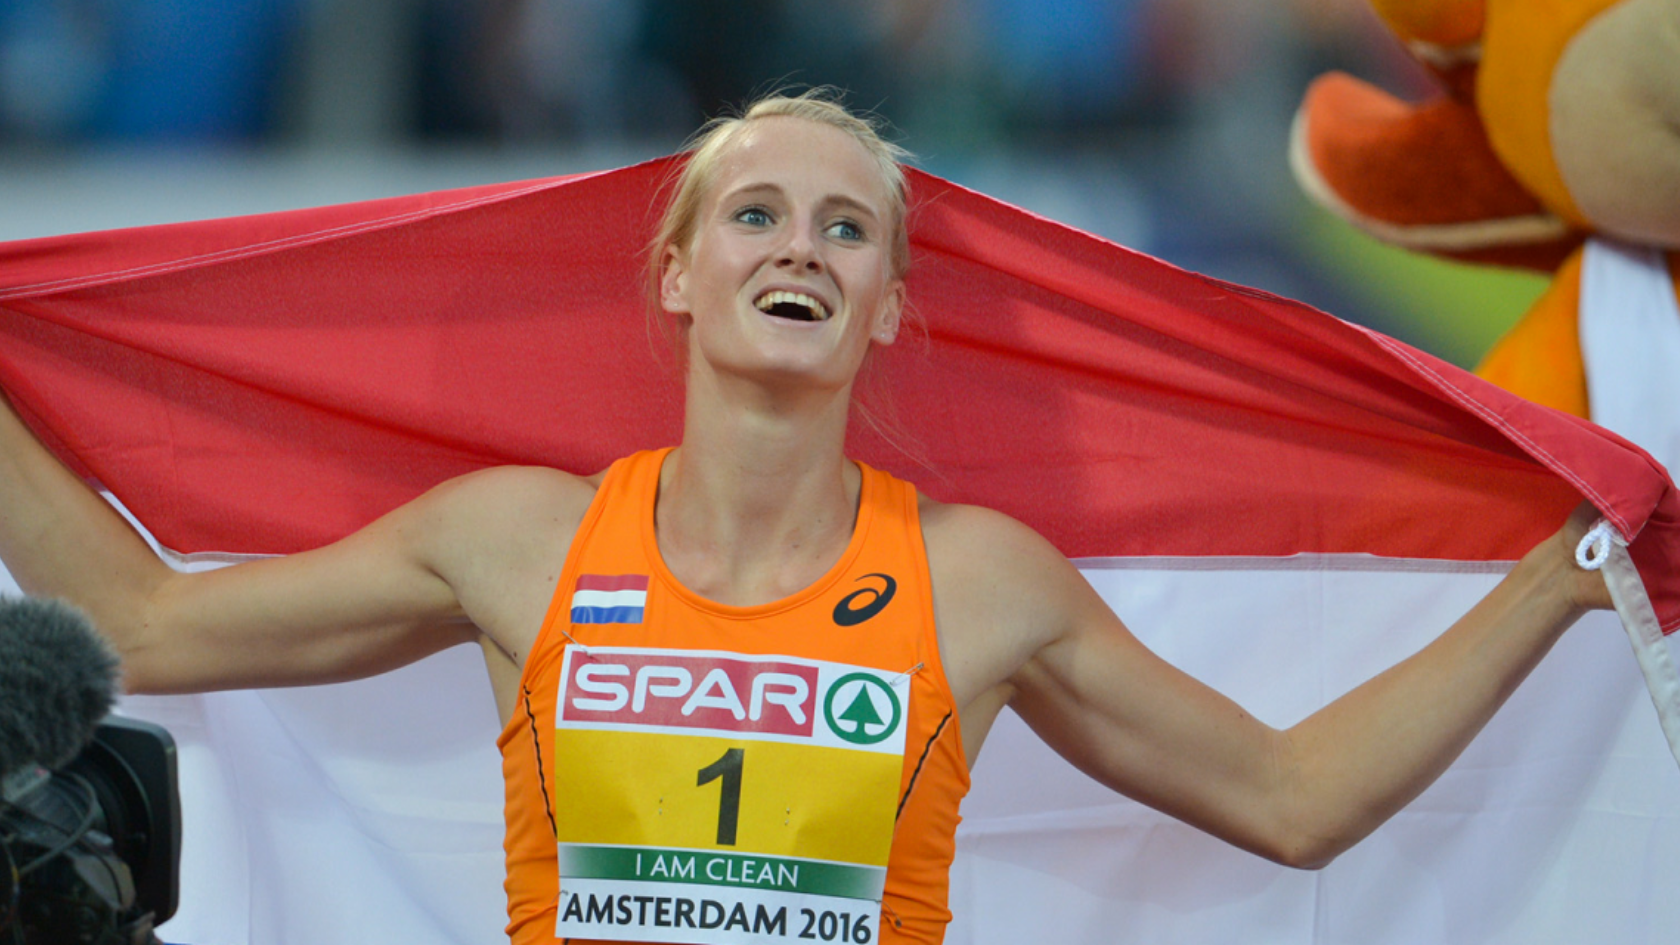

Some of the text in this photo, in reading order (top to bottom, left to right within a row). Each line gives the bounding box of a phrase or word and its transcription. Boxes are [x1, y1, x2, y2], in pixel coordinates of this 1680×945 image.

[572, 663, 809, 725] SPAR
[696, 748, 745, 846] 1
[635, 853, 799, 888] I AM CLEAN
[562, 893, 872, 945] AMSTERDAM 2016
